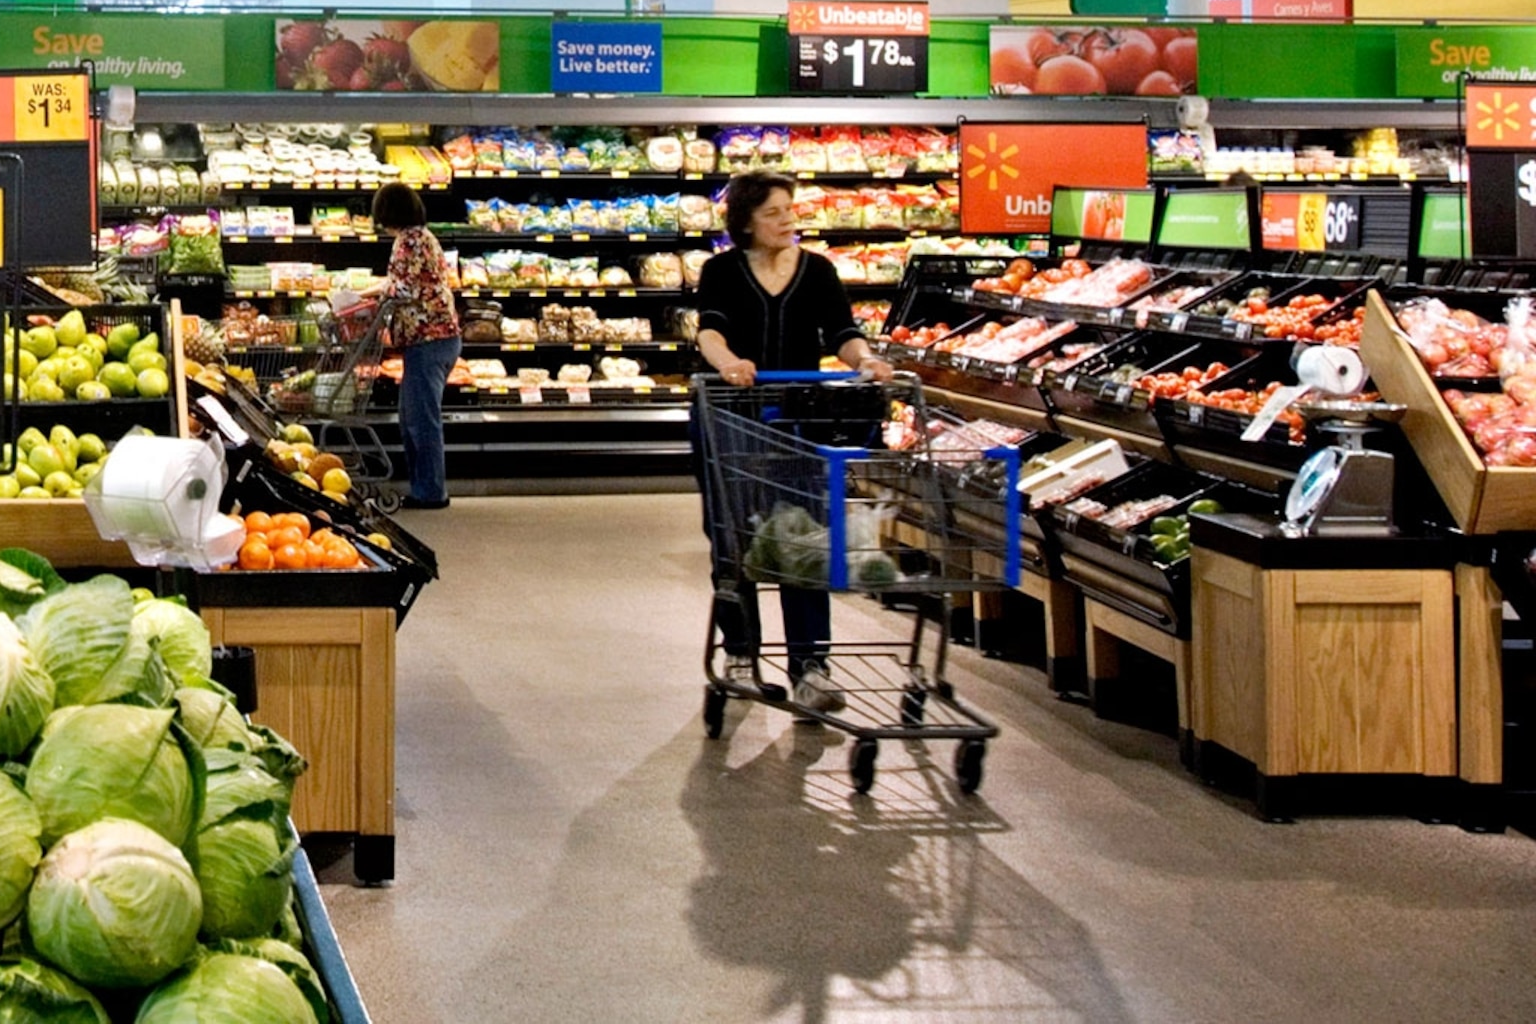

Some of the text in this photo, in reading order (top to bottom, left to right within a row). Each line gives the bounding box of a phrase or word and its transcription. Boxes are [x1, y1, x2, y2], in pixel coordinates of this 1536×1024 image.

[818, 6, 924, 25] Unbeatable
[1273, 2, 1303, 17] Carnes
[1312, 0, 1333, 14] Aves
[33, 26, 104, 55] Save
[557, 40, 655, 60] Save money.
[1430, 39, 1491, 66] Save
[138, 57, 185, 78] living.
[560, 59, 652, 74] Live better.
[32, 83, 67, 96] WAS:
